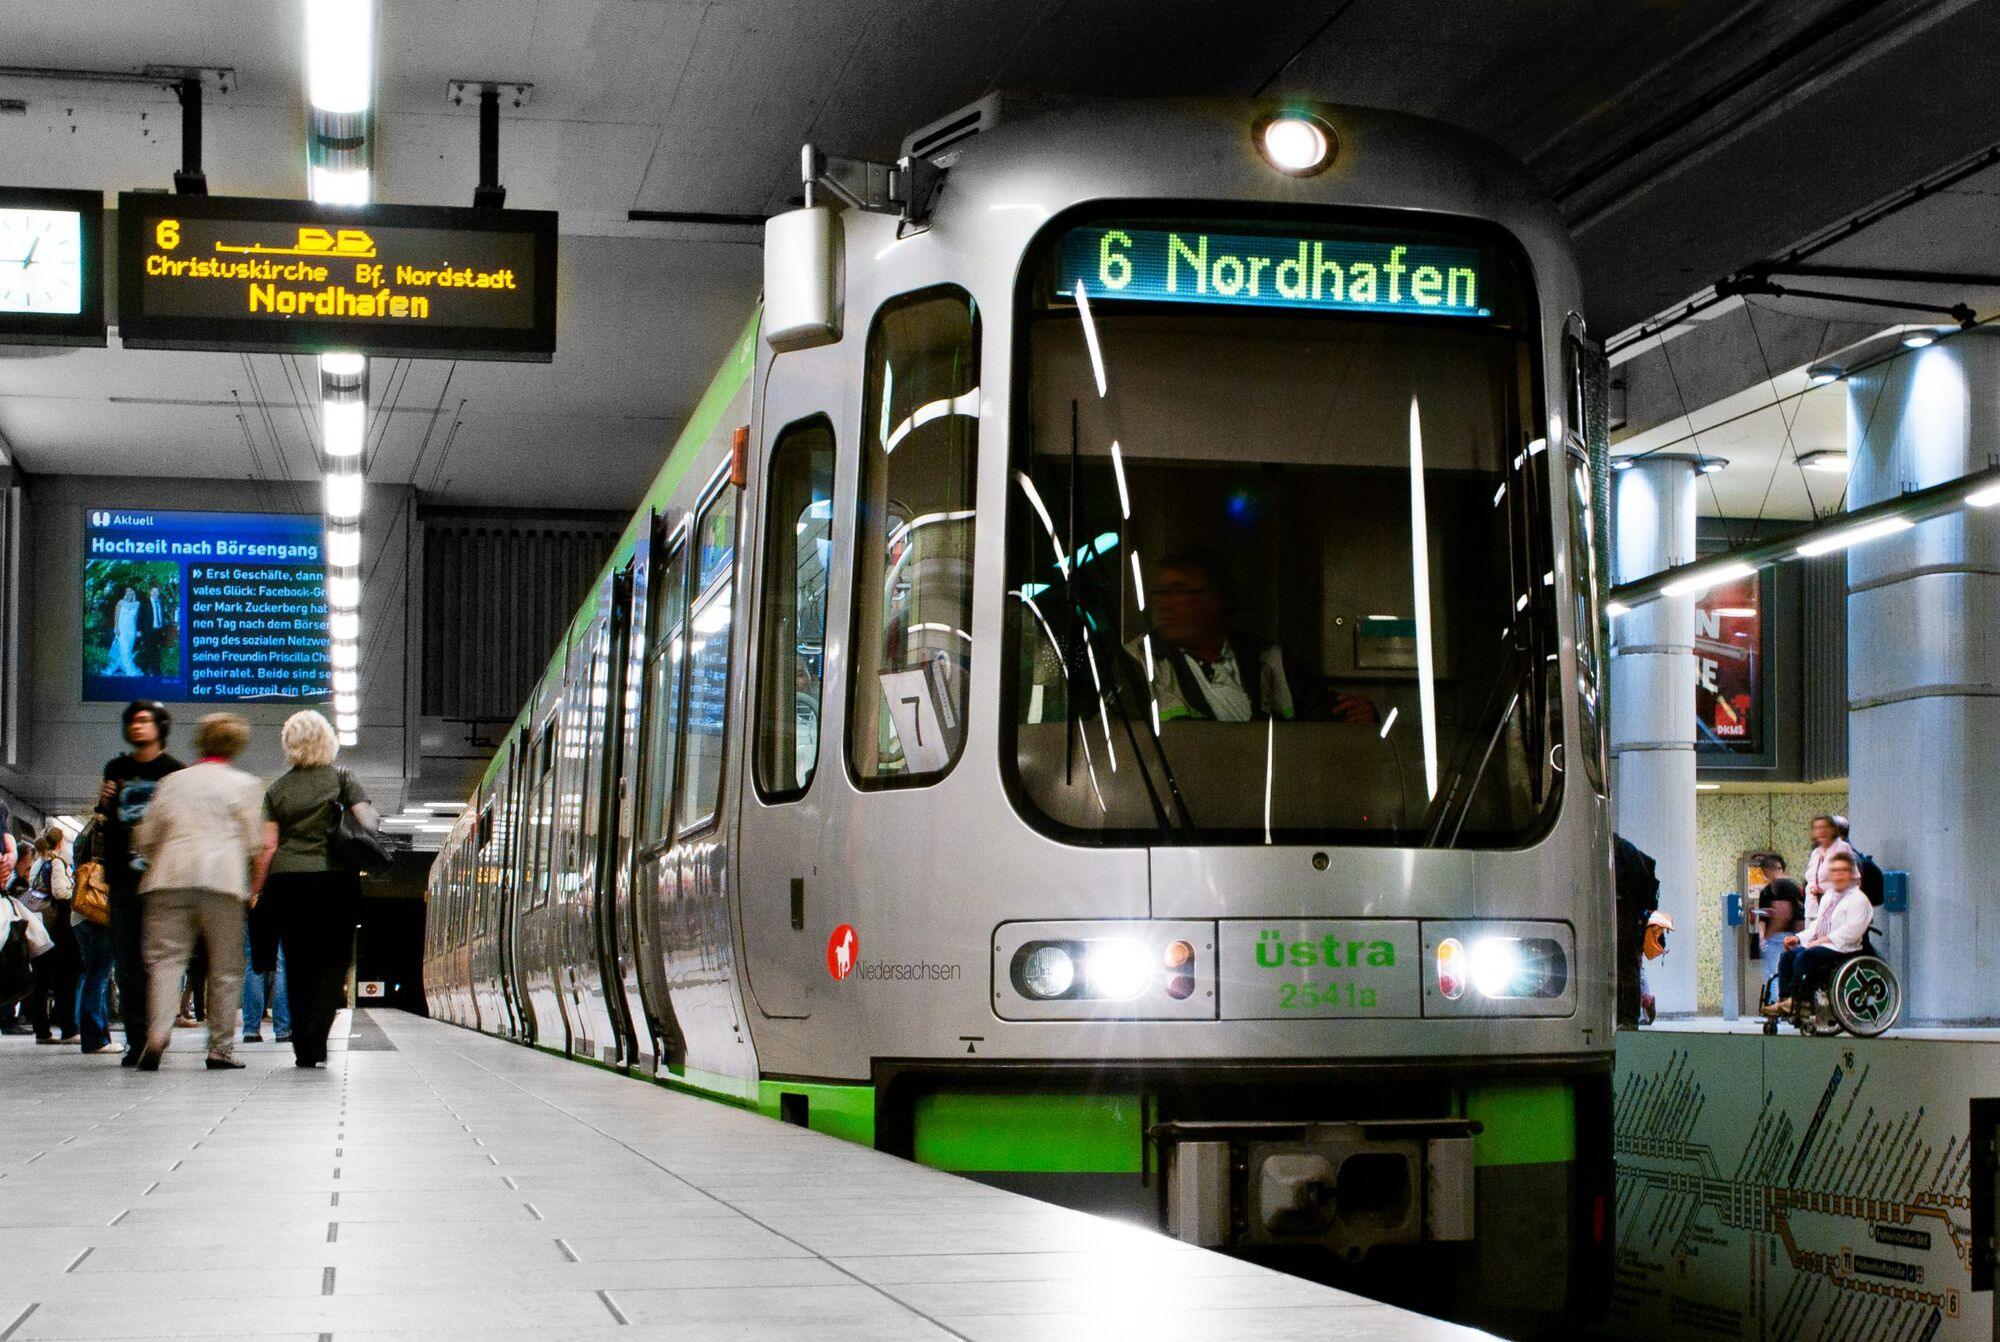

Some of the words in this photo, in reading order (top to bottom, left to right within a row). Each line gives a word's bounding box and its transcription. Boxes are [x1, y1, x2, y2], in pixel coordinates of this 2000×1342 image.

[156, 219, 180, 250] 6
[146, 255, 328, 282] Christuskirche
[356, 263, 386, 288] Bf.
[396, 265, 517, 289] Nordstadt
[1100, 230, 1132, 290] 6
[1167, 233, 1476, 307] Nordhafen
[250, 283, 429, 318] Nordhafen
[113, 515, 154, 526] Aktuell
[92, 538, 167, 554] Hochzeit
[171, 540, 211, 554] nach
[216, 540, 319, 559] Börsengang
[206, 568, 231, 579] Erst
[233, 569, 293, 581] Geschäfte,
[296, 571, 324, 580] dann
[192, 586, 222, 596] vates
[223, 585, 257, 596] Glück:
[192, 602, 213, 612] der
[214, 602, 243, 612] Mark
[245, 602, 308, 615] Zuckerberg
[311, 603, 328, 613] hat
[193, 619, 214, 628] nen
[216, 618, 236, 631] Tag
[239, 619, 265, 629] nach
[267, 619, 291, 629] dem
[192, 636, 219, 647] gang
[221, 635, 241, 645] des
[242, 635, 286, 645] sozialen
[192, 651, 220, 661] seine
[222, 651, 268, 662] Freundin
[269, 652, 310, 662] Priscilla
[192, 667, 255, 680] geheiratet.
[257, 668, 290, 678] Beide
[292, 668, 317, 679] sind
[192, 684, 212, 694] der
[215, 684, 278, 695] Studienzeit
[281, 685, 299, 695] ein
[901, 696, 923, 747] 7
[1717, 725, 1744, 735] DKMS
[1255, 930, 1396, 968] üstra
[855, 960, 961, 980] Niedersachsen
[1279, 981, 1377, 1009] 2541a
